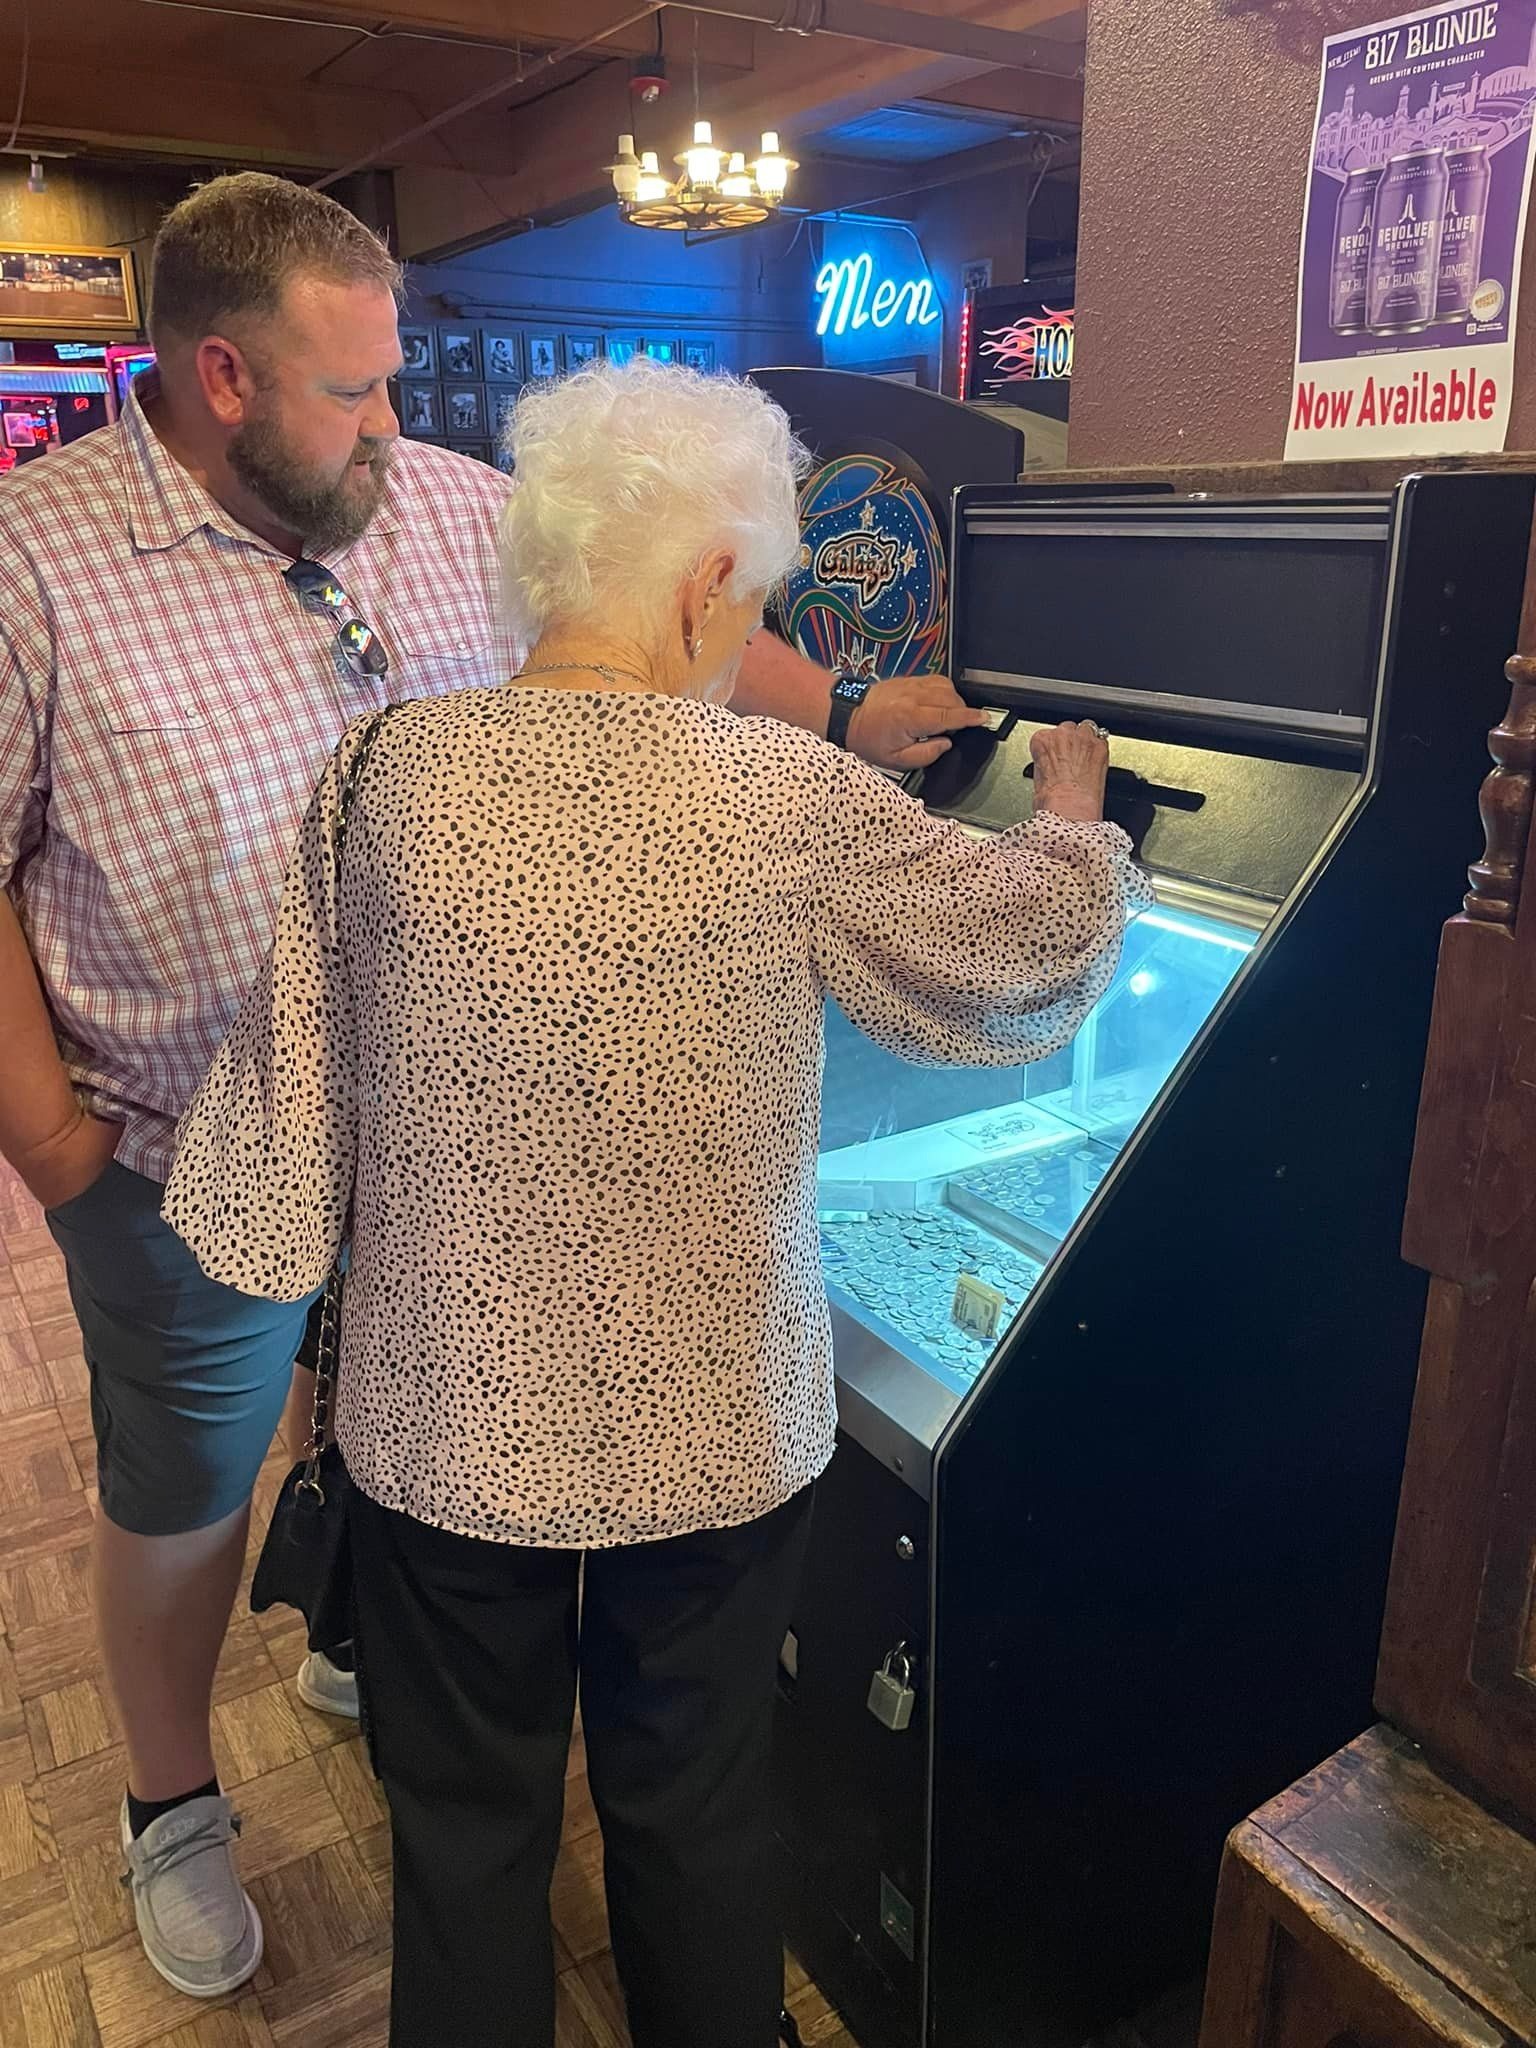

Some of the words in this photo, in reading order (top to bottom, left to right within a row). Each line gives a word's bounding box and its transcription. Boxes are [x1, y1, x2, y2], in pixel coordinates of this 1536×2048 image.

[1365, 30, 1400, 70] 817
[1405, 2, 1499, 60] BLONDE
[1369, 72, 1395, 85] BREWED
[1395, 67, 1411, 79] WITH
[1412, 58, 1446, 75] COWTOWN
[1447, 50, 1485, 66] CHARACTER
[1378, 221, 1435, 247] REVOLVER
[1385, 238, 1425, 251] BREWING
[816, 252, 939, 335] Men
[1392, 270, 1427, 287] BLONDE
[1294, 381, 1354, 430] Now
[1356, 367, 1497, 427] Available
[817, 536, 896, 603] Galaga
